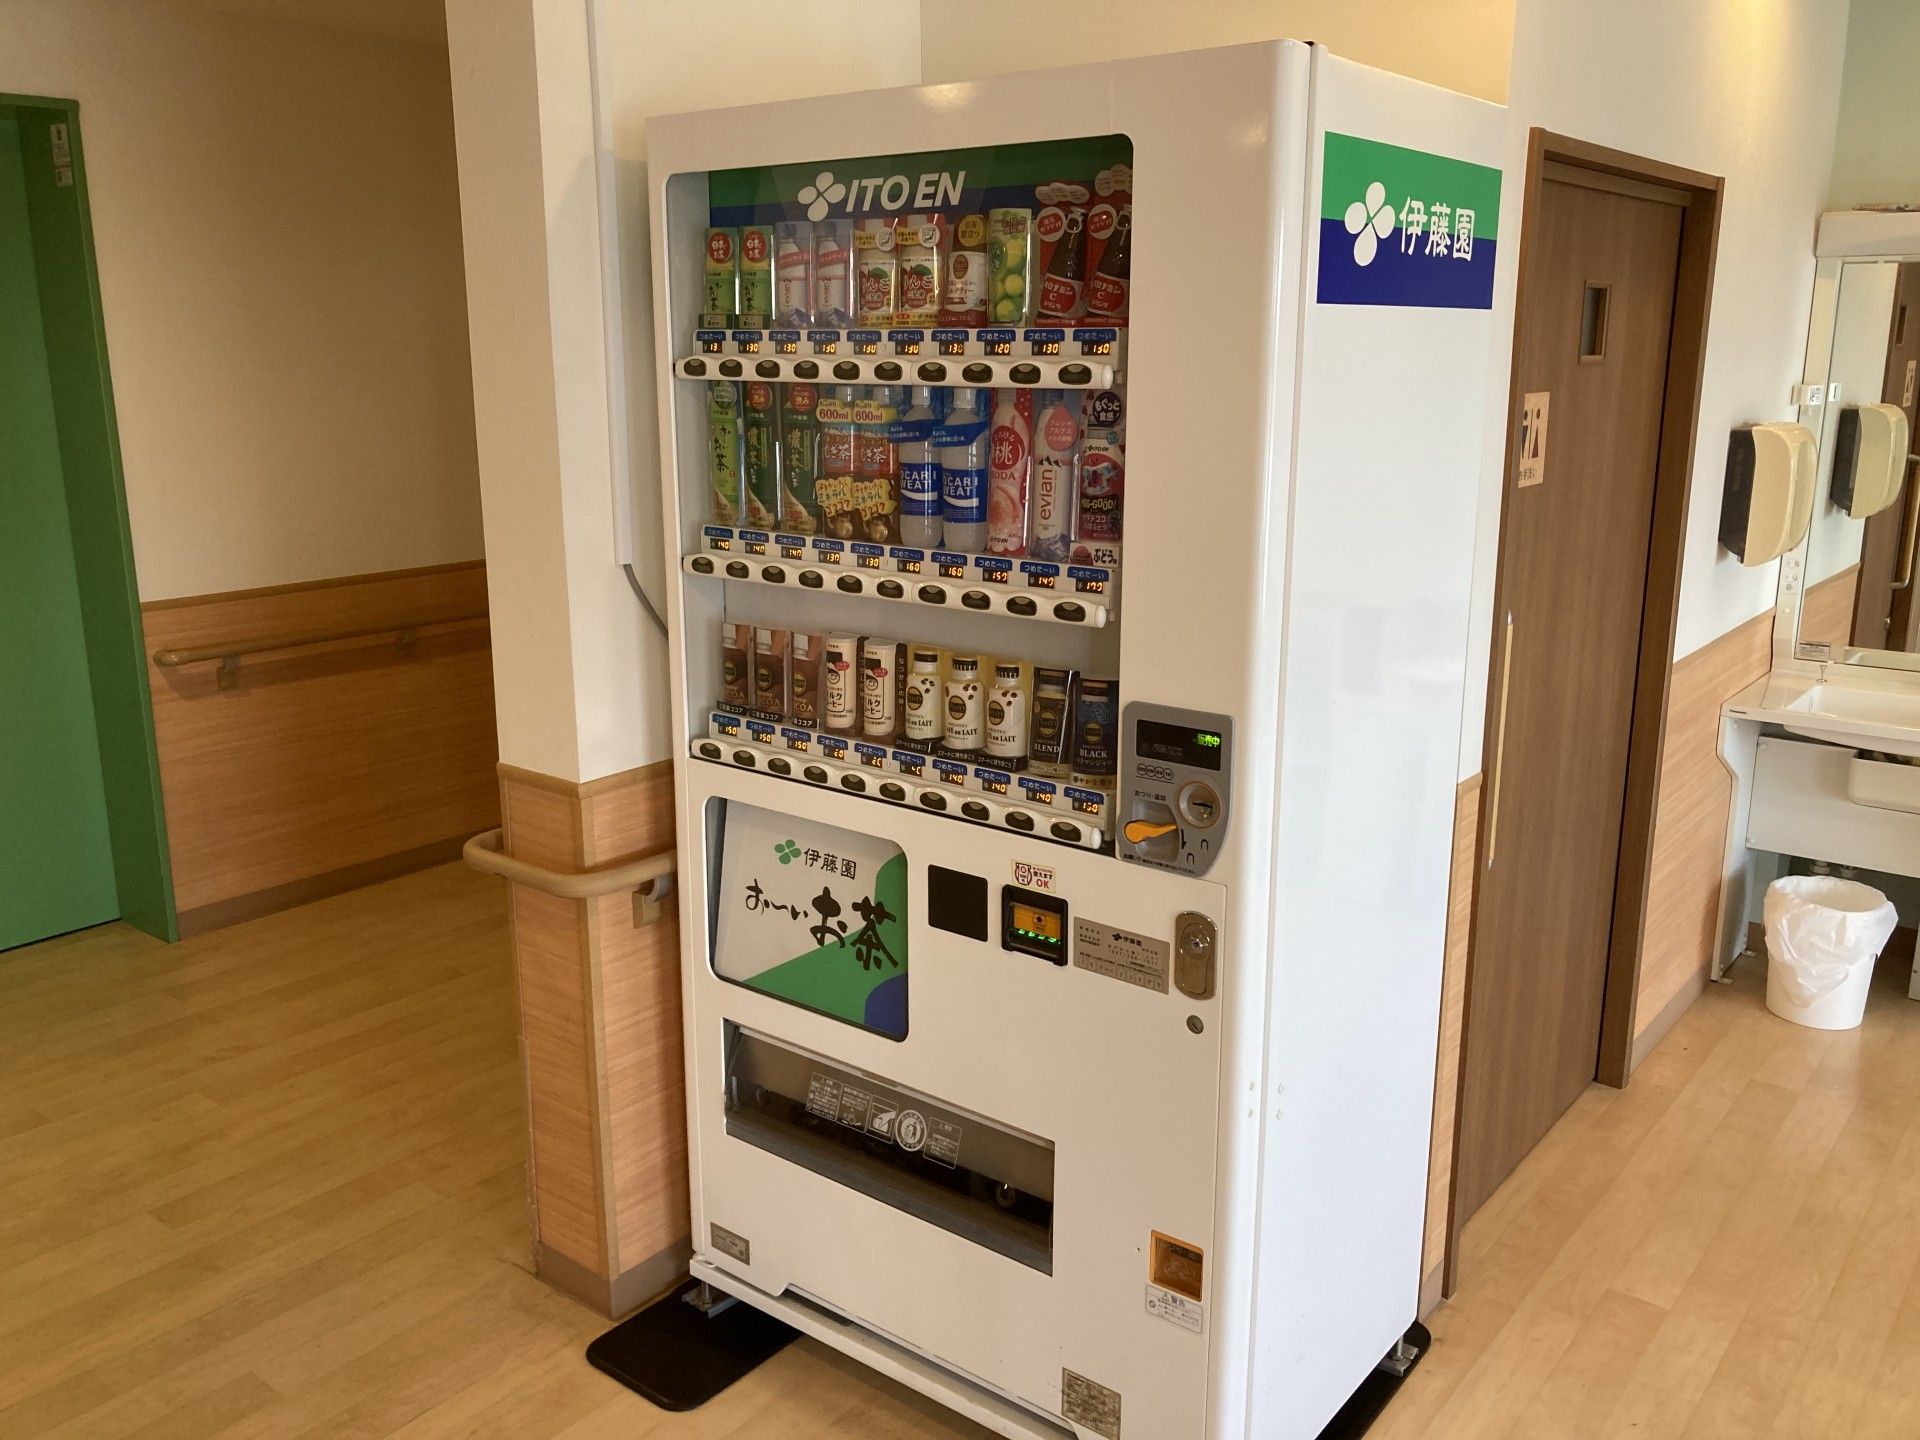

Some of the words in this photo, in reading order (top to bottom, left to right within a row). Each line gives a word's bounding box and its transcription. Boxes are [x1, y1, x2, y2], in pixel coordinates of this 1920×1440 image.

[846, 175, 910, 213] ITO
[914, 170, 966, 208] EN
[1399, 195, 1476, 262] 伊藤園
[1049, 293, 1057, 301] C
[1097, 291, 1105, 299] C
[819, 409, 849, 420] 600ml
[856, 411, 882, 422] 600ml
[994, 441, 1014, 465] 桃
[1040, 469, 1055, 521] evian
[918, 718, 933, 727] LAIT
[962, 728, 979, 736] LAIT
[1000, 735, 1016, 744] LAIT
[1079, 748, 1107, 758] BLACK
[803, 847, 857, 881] 伊藤園
[1036, 879, 1050, 889] OK
